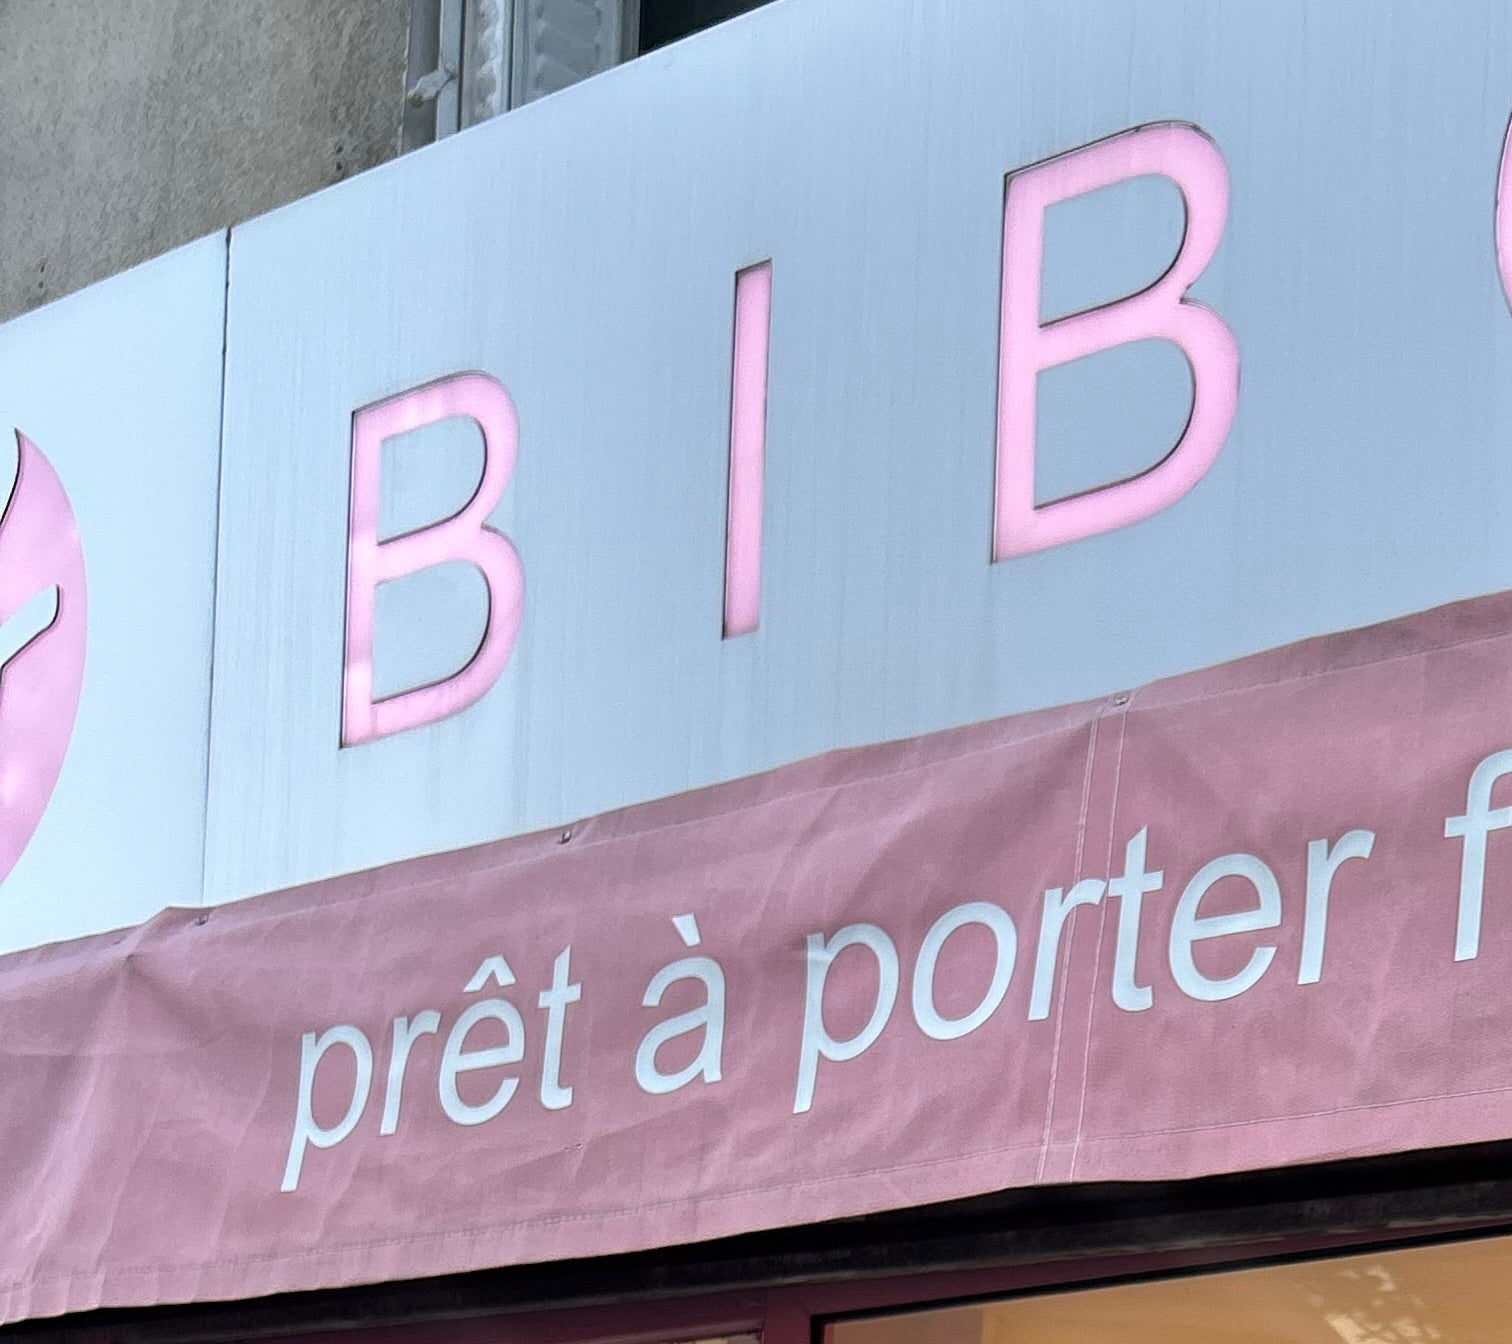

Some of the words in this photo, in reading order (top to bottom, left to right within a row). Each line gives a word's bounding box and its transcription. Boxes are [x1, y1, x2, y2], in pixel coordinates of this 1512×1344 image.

[280, 947, 581, 1192] prêt
[634, 913, 726, 1096] à
[793, 826, 1376, 1114] porter
